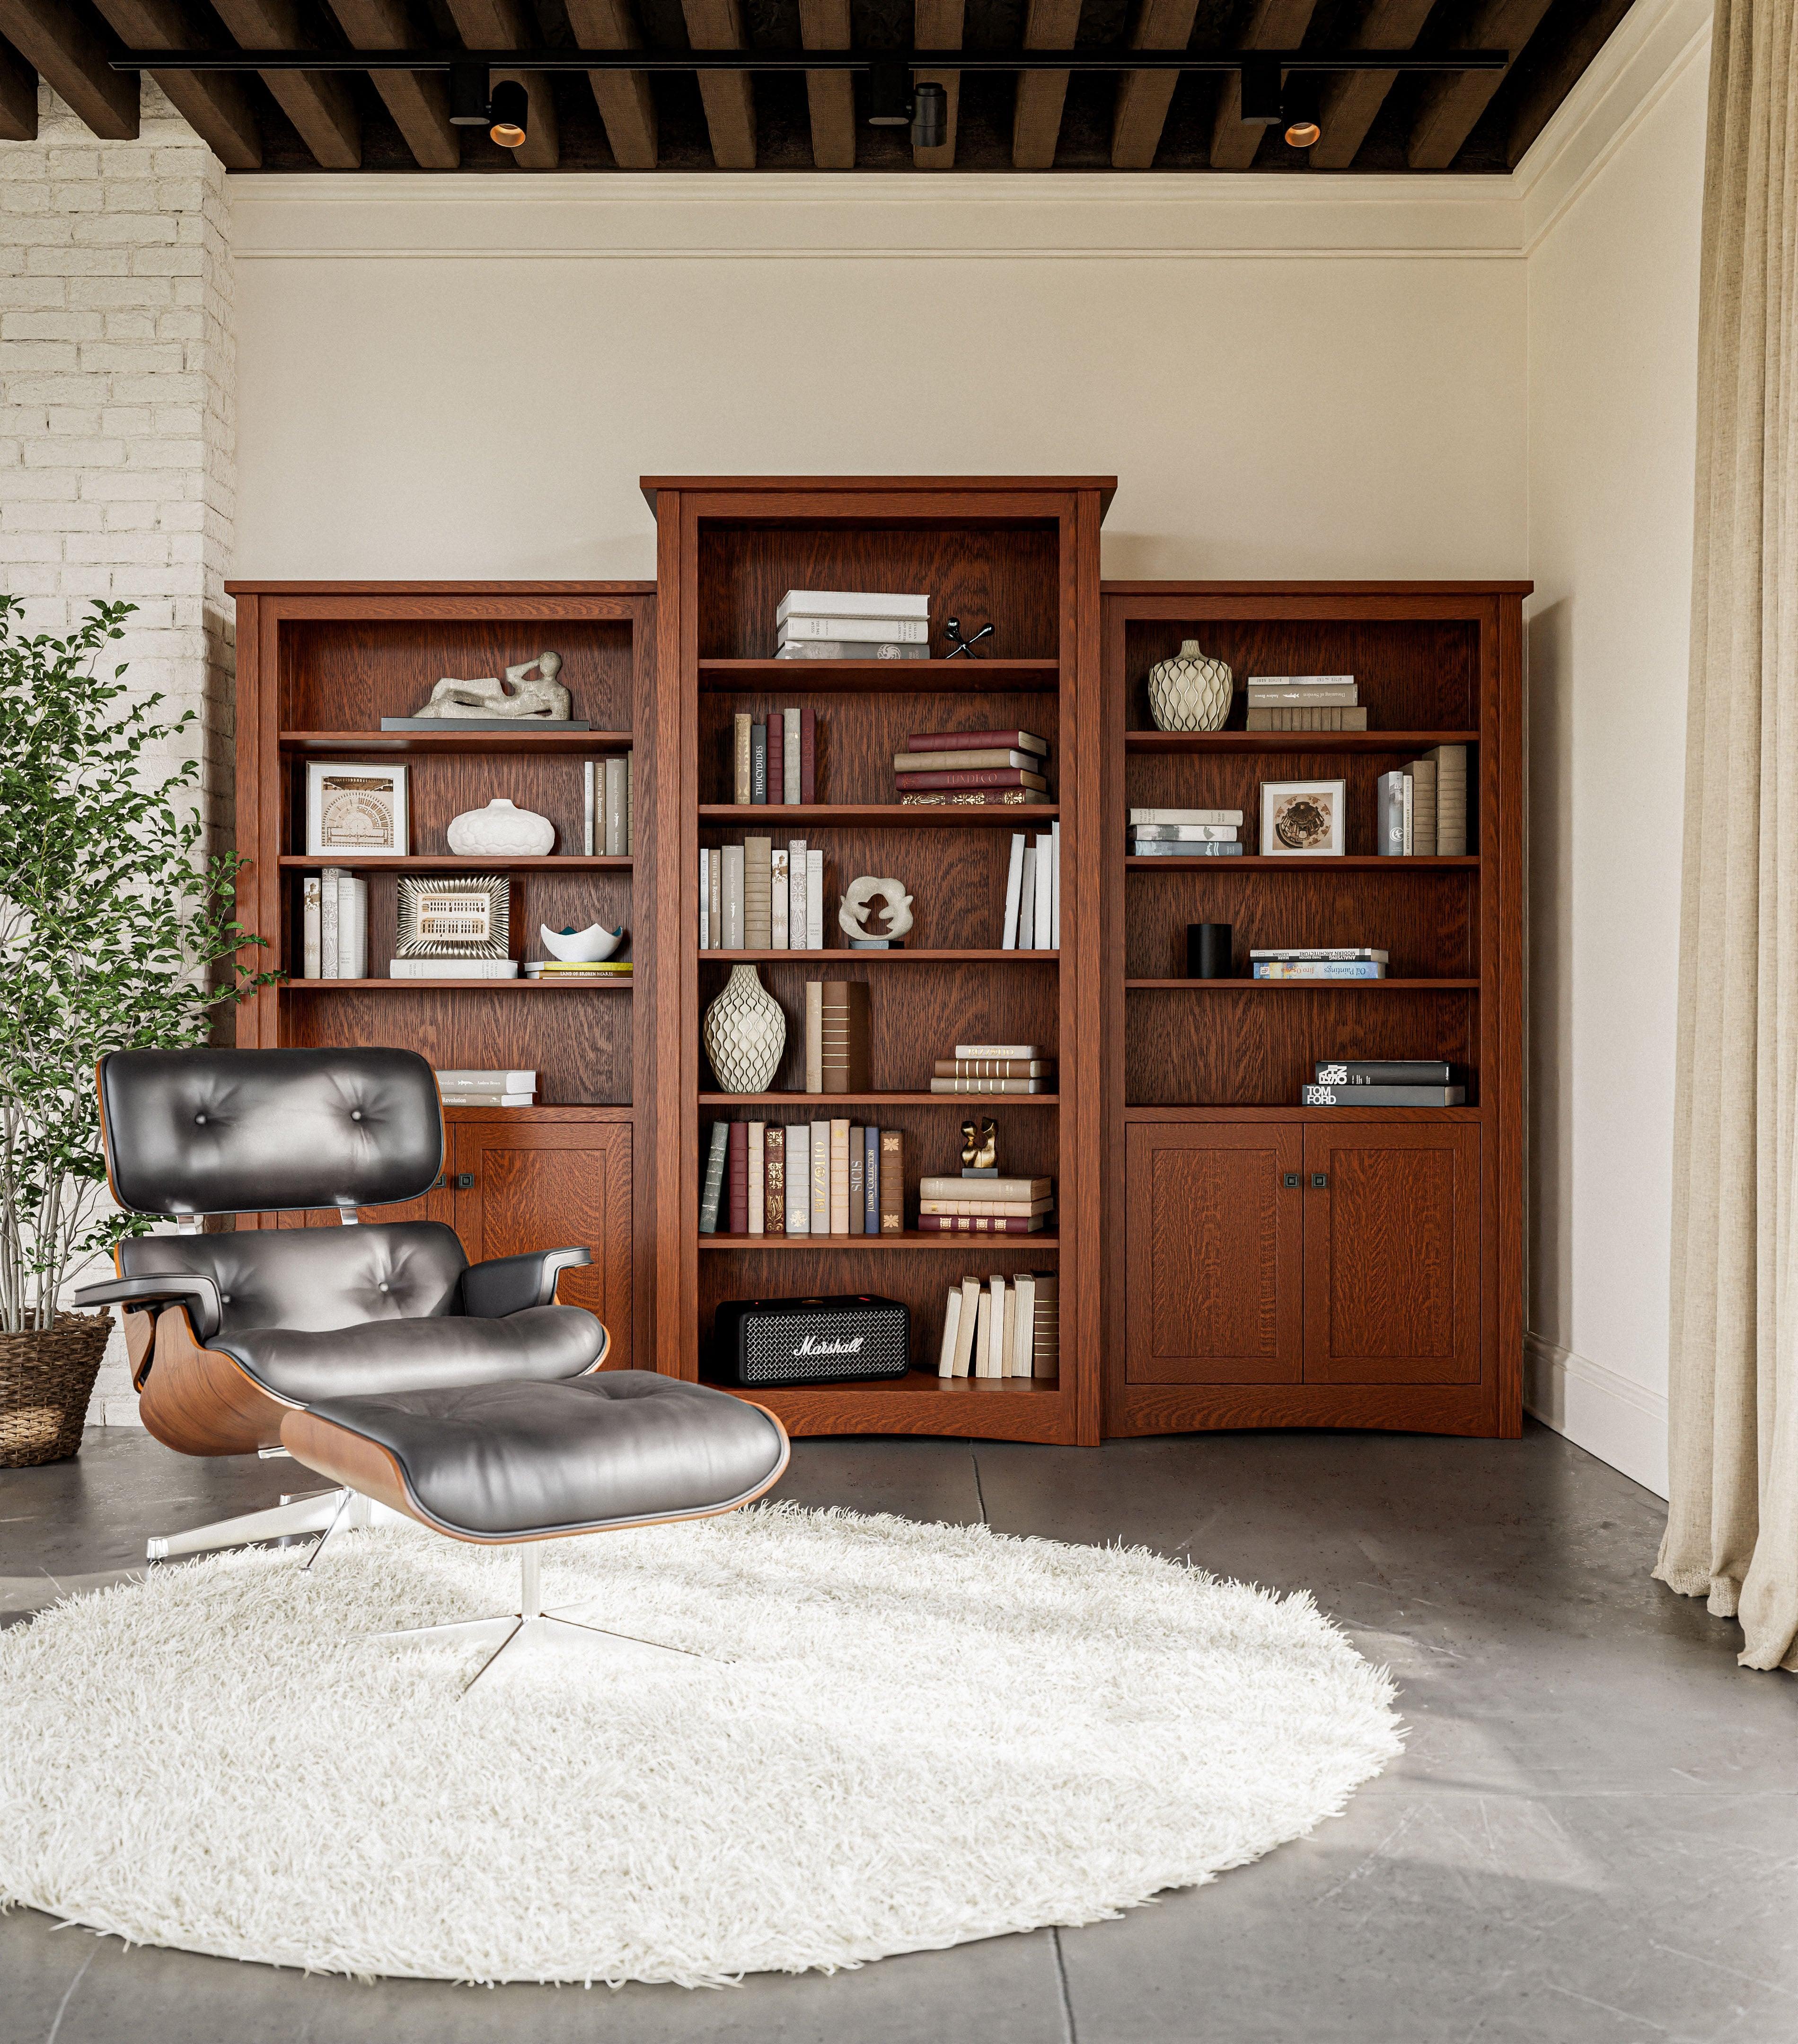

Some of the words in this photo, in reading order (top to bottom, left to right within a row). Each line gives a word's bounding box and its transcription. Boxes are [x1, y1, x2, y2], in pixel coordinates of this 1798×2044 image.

[1324, 966, 1354, 975] Paintings
[1307, 1086, 1331, 1095] TOM
[1307, 1095, 1337, 1104] FORD
[851, 1161, 862, 1191] SICIS
[867, 1190, 876, 1212] JUMBO
[793, 1335, 864, 1356] Marshall
